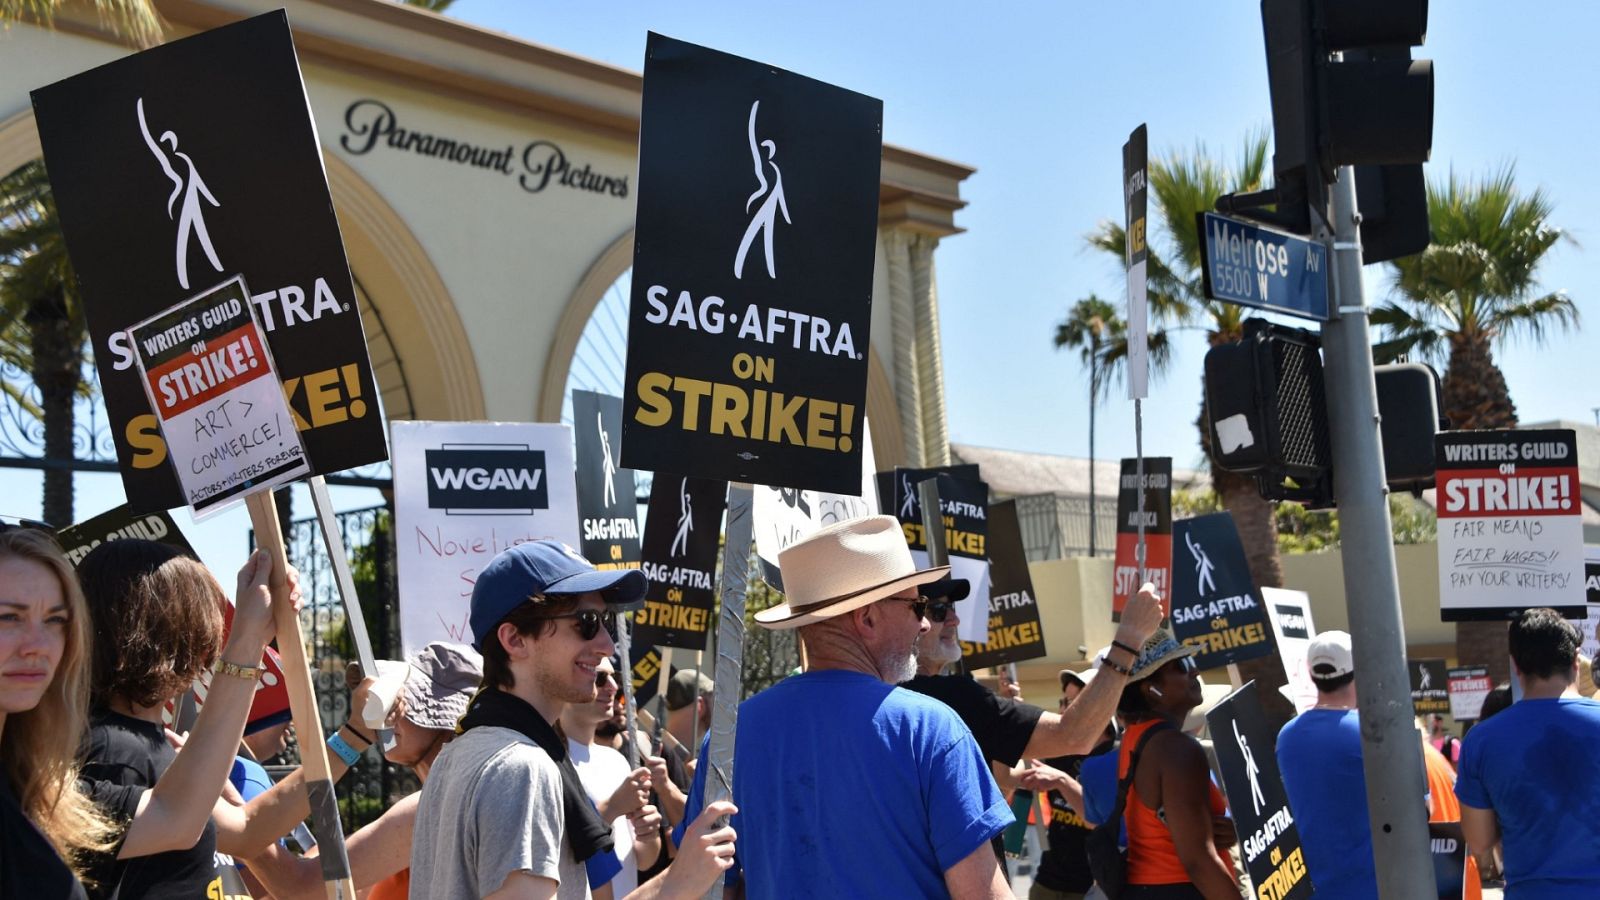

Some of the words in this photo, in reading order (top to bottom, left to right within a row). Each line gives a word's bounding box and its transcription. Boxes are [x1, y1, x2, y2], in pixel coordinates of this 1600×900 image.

[340, 99, 513, 175] Paramount
[519, 140, 628, 198] Pictures
[1212, 220, 1288, 277] Melrose
[1216, 263, 1251, 297] 5500
[1257, 272, 1268, 301] W
[143, 317, 200, 357] WRITERS
[202, 298, 242, 329] GUILD
[191, 340, 208, 356] ON
[158, 335, 258, 409] STRIKE!
[732, 352, 775, 383] ON
[194, 399, 233, 442] ART
[634, 372, 855, 453] STRIKE!
[191, 412, 283, 475] COMMERCE!
[1444, 443, 1518, 461] WRITERS
[1521, 442, 1568, 460] GUILD
[265, 445, 305, 468] FOREVER
[1499, 463, 1515, 474] ON
[431, 467, 542, 491] WGAW
[1149, 474, 1168, 489] GUILD
[1445, 475, 1572, 512] STRIKE!
[1128, 512, 1158, 526] AMICA
[1453, 520, 1485, 539] FAIR
[1493, 519, 1543, 541] MEANS
[901, 523, 985, 555] STIKE!
[610, 544, 622, 559] ON
[1453, 548, 1496, 563] FAIR
[1450, 572, 1474, 588] PAY
[1478, 570, 1510, 586] YOUR
[1516, 572, 1571, 589] WRITERS!
[667, 588, 682, 602] ON
[635, 601, 708, 632] STRIKE!
[1211, 617, 1229, 630] ON
[1270, 846, 1282, 866] ON
[1258, 846, 1307, 900] STRIKE!
